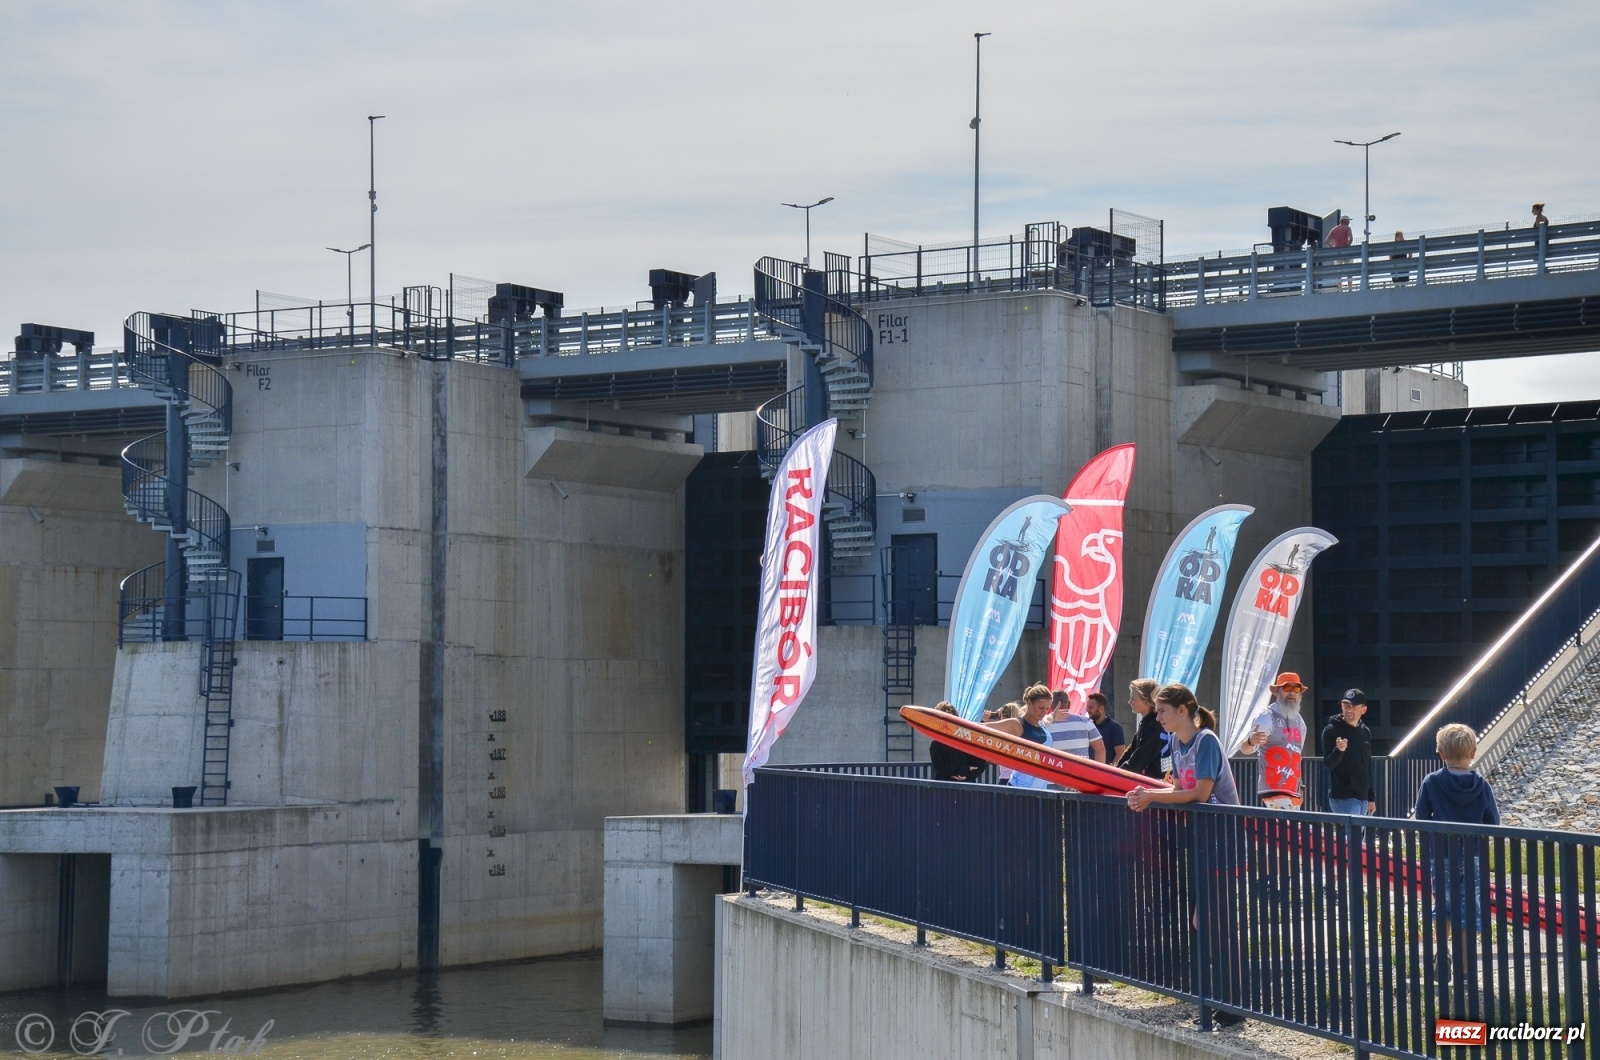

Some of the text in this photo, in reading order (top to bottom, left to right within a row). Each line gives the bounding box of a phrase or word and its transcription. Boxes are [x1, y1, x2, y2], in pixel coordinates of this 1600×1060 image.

[878, 313, 909, 329] Filar
[879, 328, 909, 345] F1-1
[246, 364, 271, 378] Filar
[258, 377, 272, 391] F2
[493, 709, 507, 720] 188
[493, 748, 507, 759] 187
[976, 735, 1011, 752] AQUA
[1015, 747, 1064, 769] MARINA
[493, 786, 506, 797] 186
[492, 825, 506, 836] 185
[492, 863, 506, 874] 184
